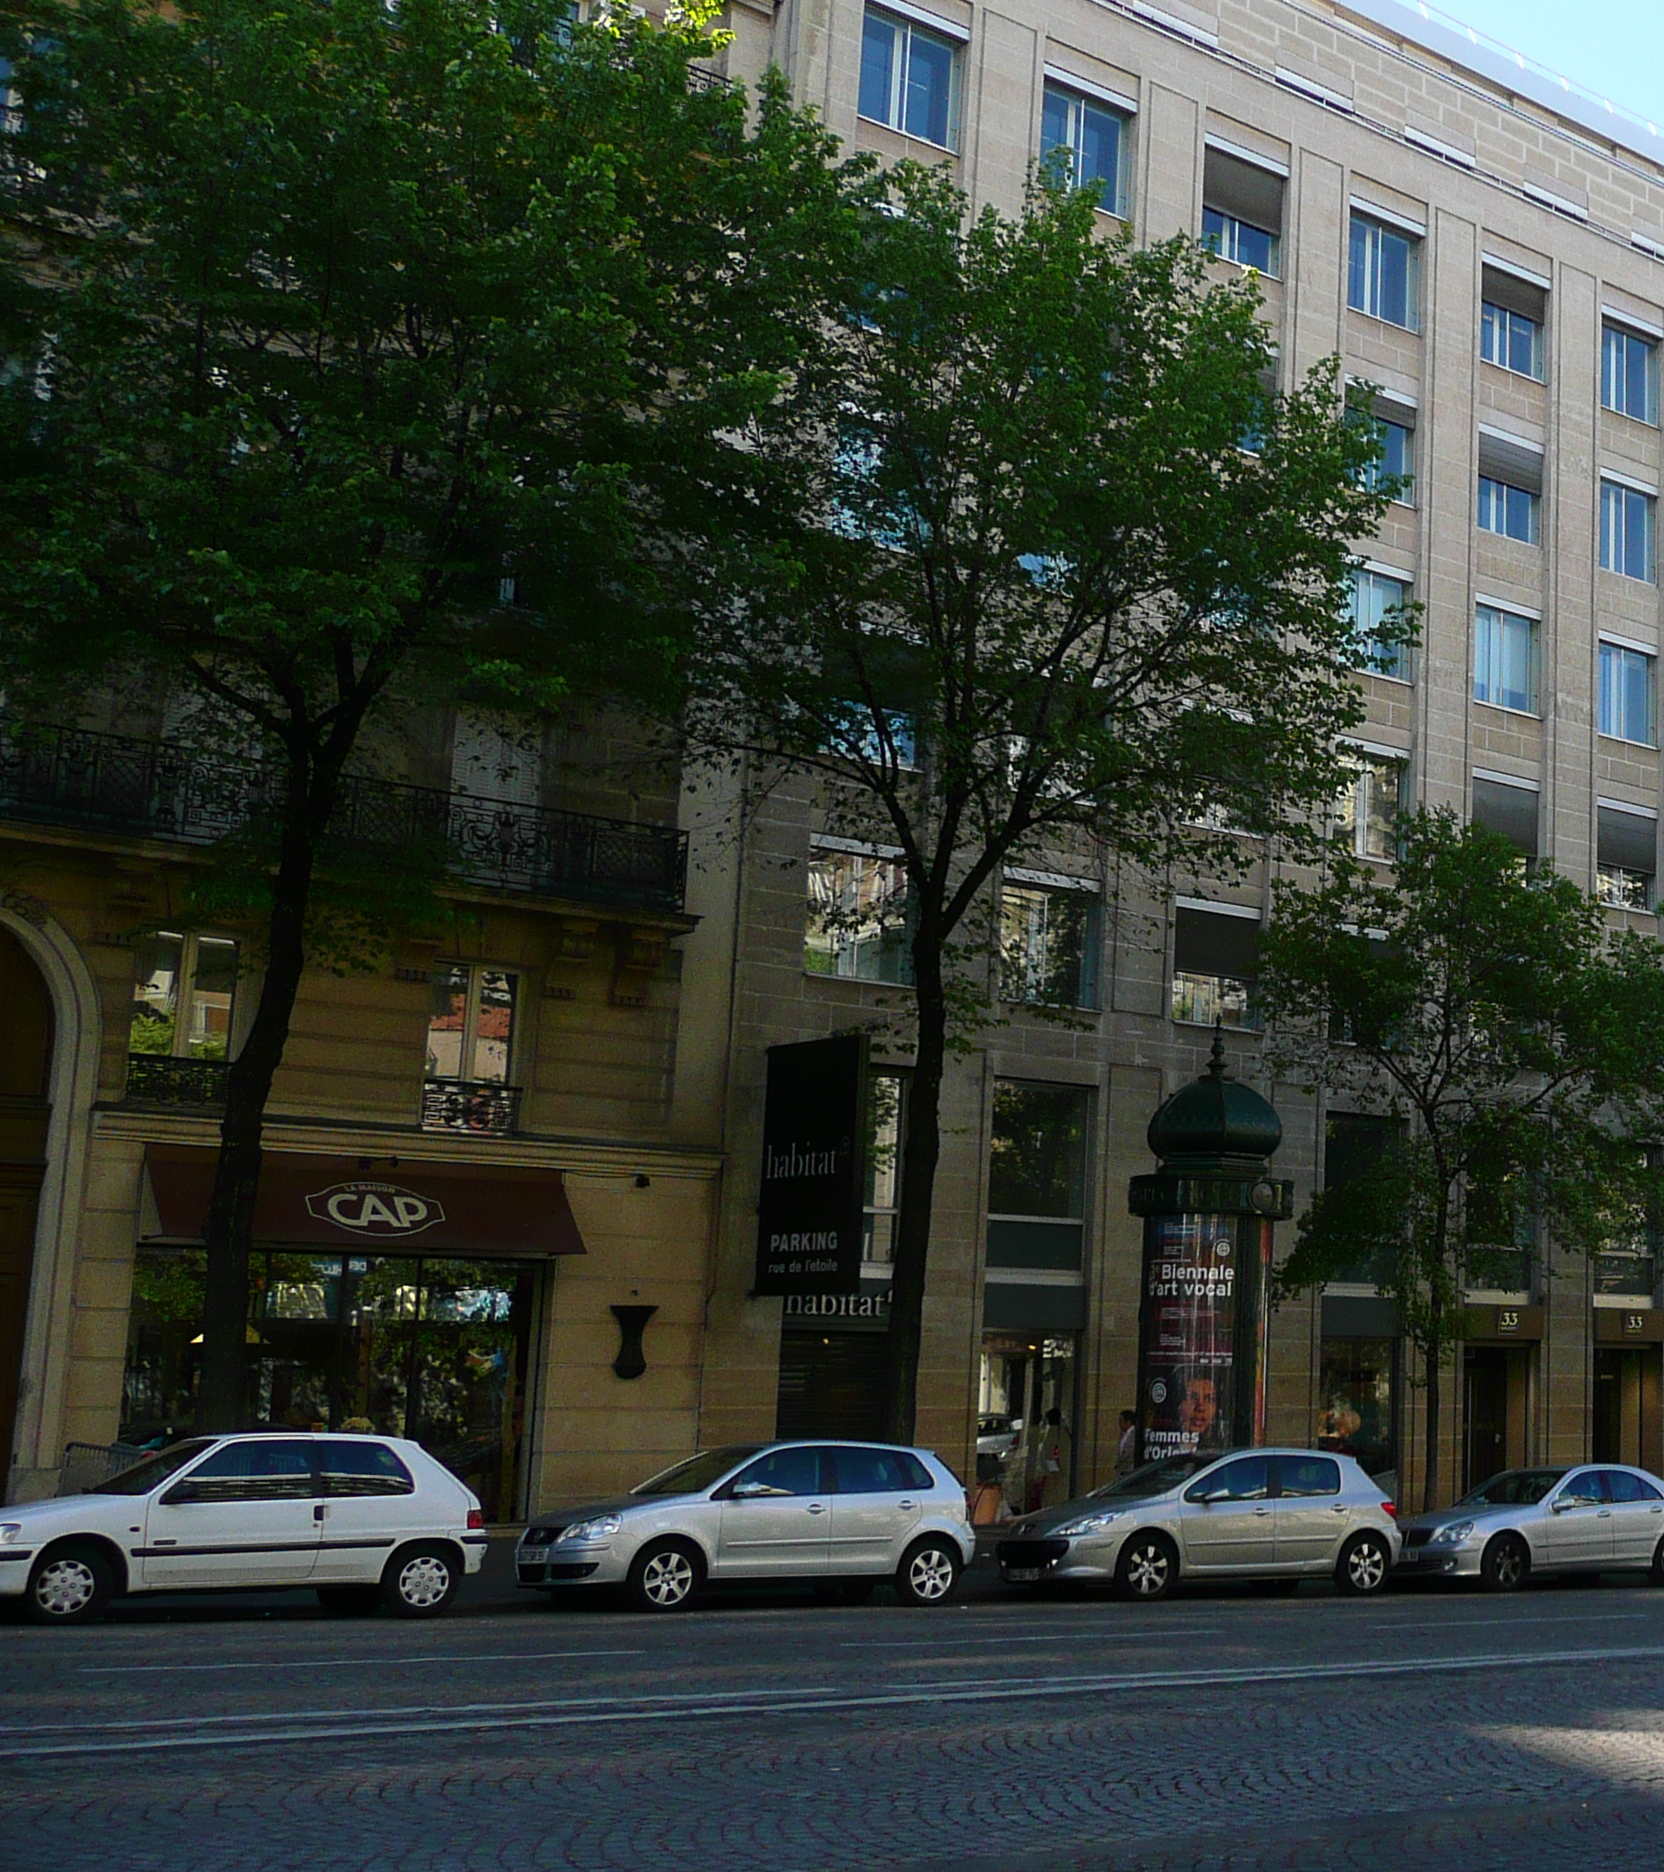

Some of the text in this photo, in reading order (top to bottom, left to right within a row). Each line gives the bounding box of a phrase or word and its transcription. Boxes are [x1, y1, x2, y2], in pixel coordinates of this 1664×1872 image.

[765, 1142, 837, 1179] habitat
[327, 1193, 428, 1228] CAP
[770, 1230, 839, 1253] PARKING
[768, 1262, 786, 1274] rue
[788, 1258, 802, 1273] de
[1161, 1263, 1236, 1280] Biennale
[1184, 1281, 1232, 1297] vocal
[1501, 1311, 1519, 1327] 33
[1627, 1315, 1643, 1329] 33
[1144, 1428, 1200, 1443] Femmes
